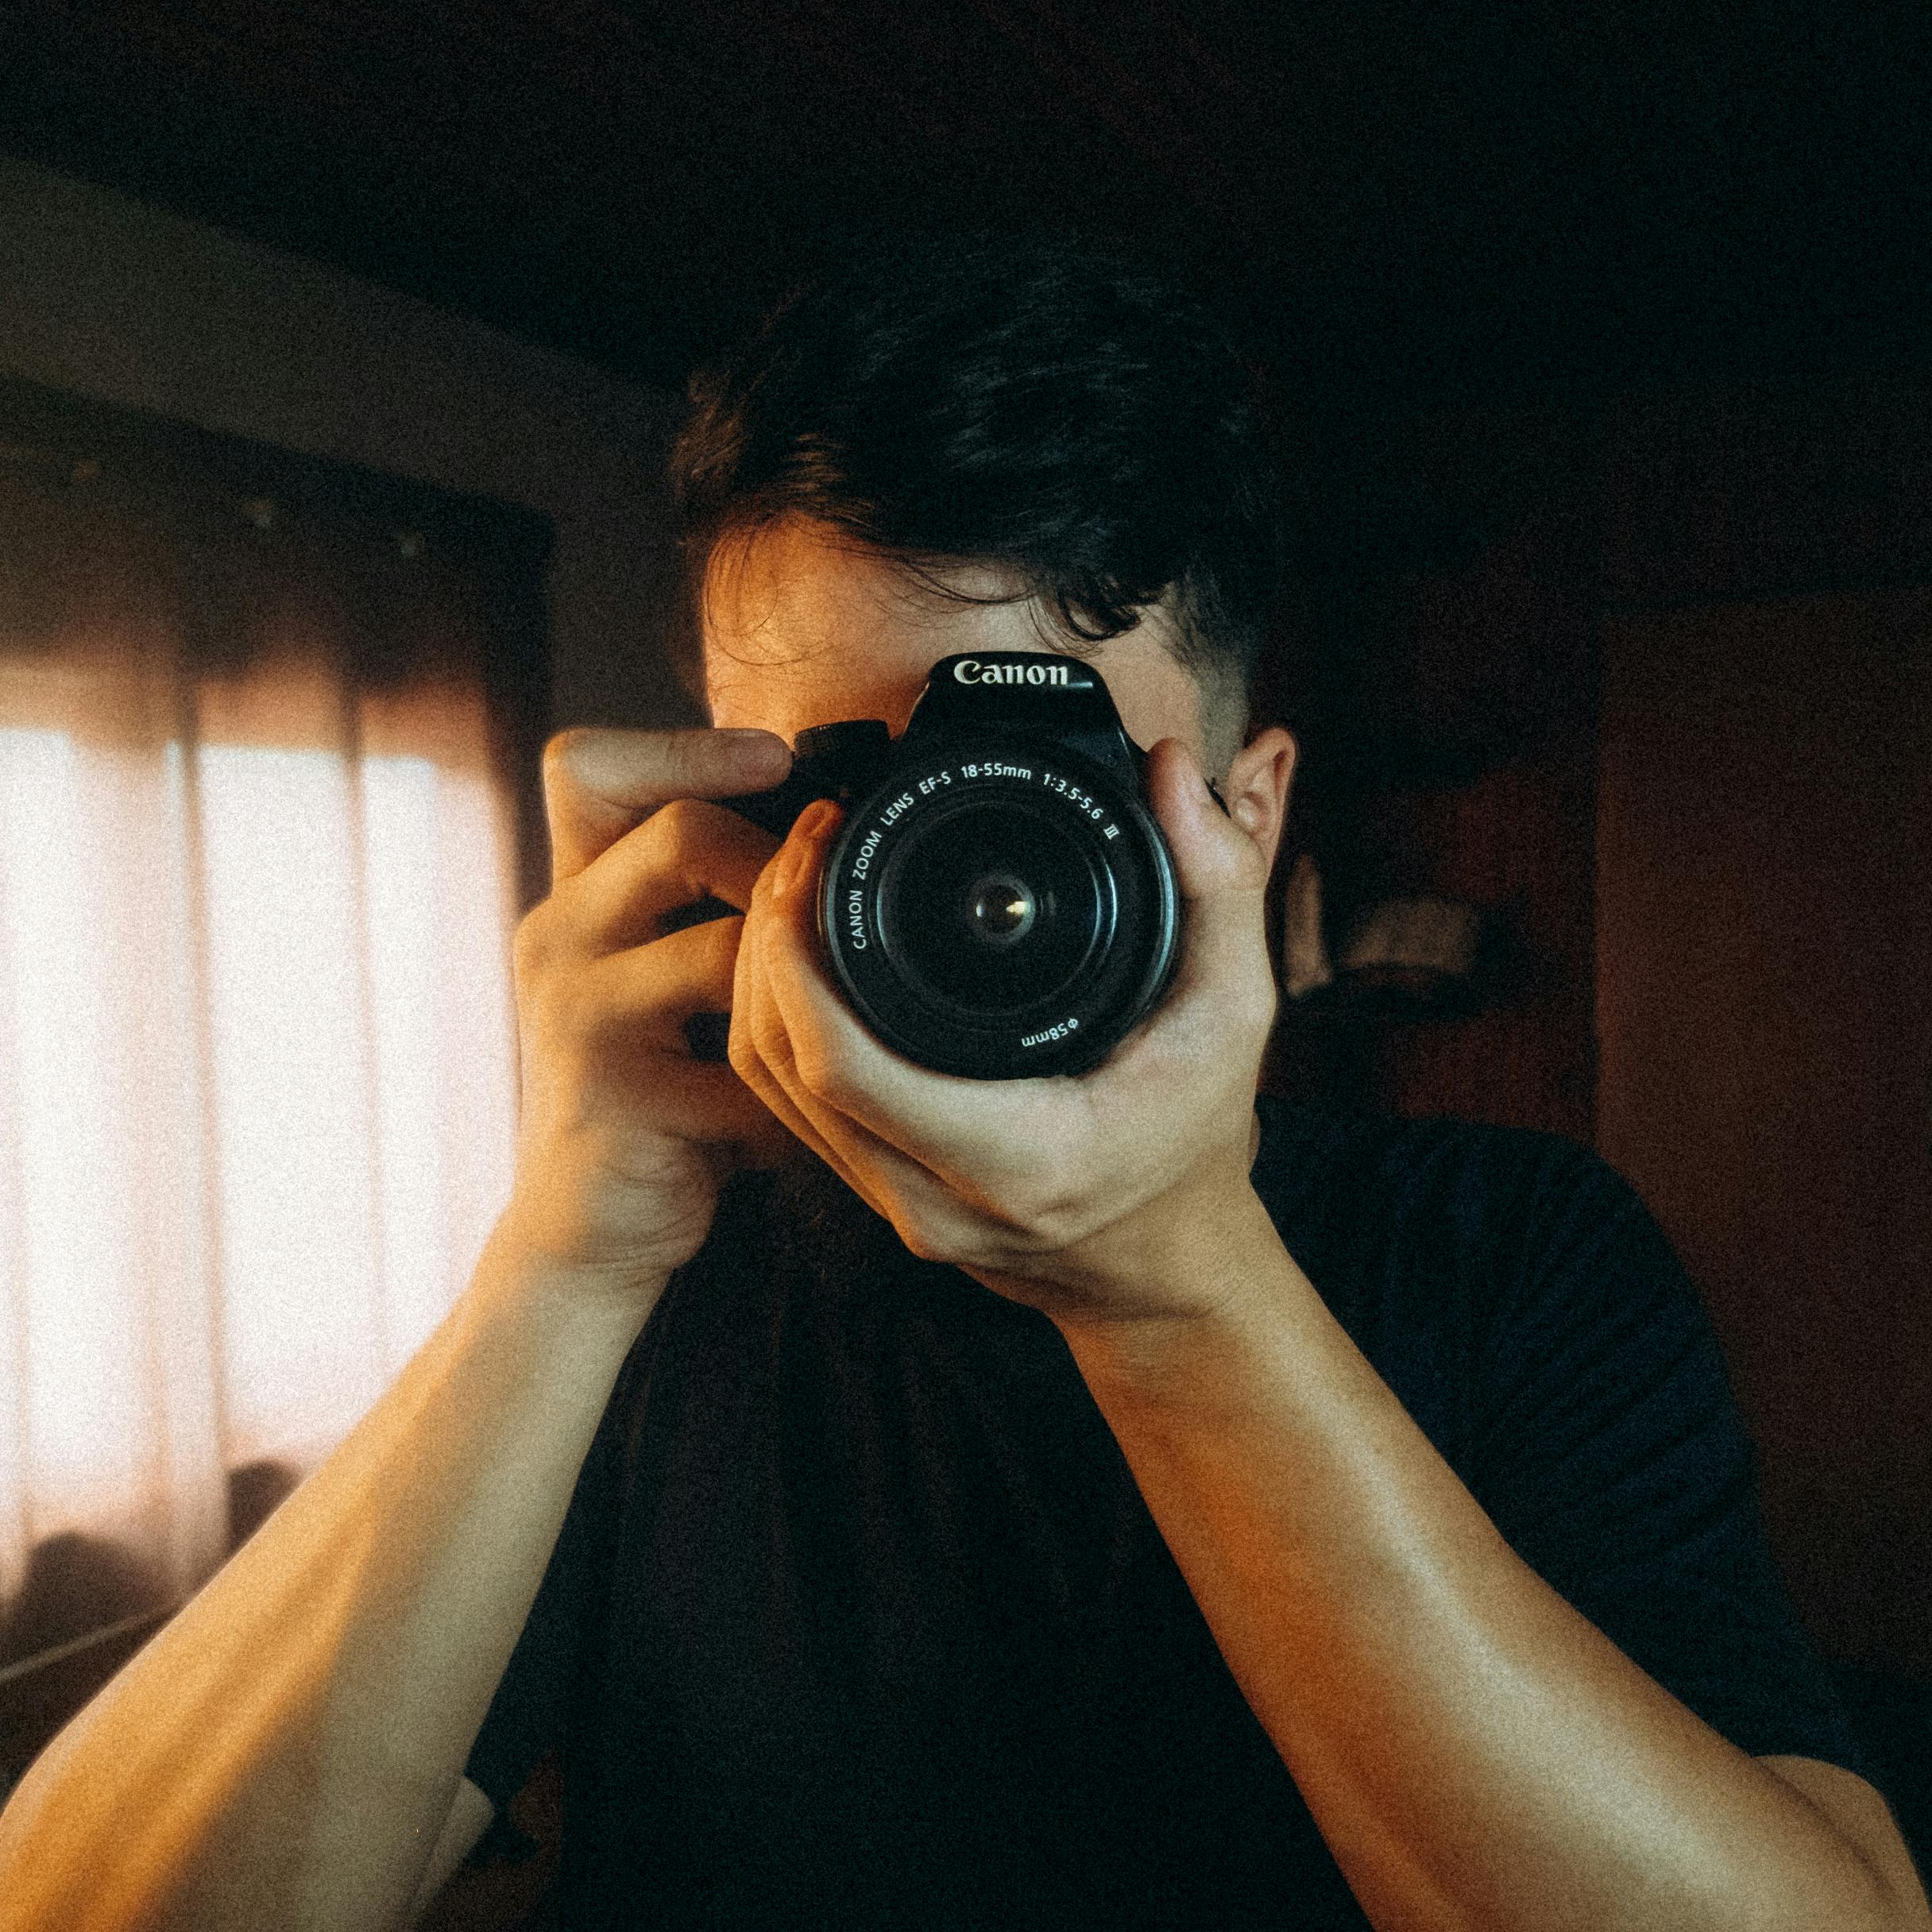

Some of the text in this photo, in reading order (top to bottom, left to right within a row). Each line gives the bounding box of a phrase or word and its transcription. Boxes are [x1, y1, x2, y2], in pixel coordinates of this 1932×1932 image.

[953, 659, 1068, 686] Canon
[918, 771, 952, 795] EF-S
[960, 762, 1032, 780] 18-55mm
[879, 792, 914, 826] LENS
[1043, 773, 1104, 820] 1:3.5-5.6
[852, 830, 883, 880] ZOOM
[848, 890, 867, 949] CANON
